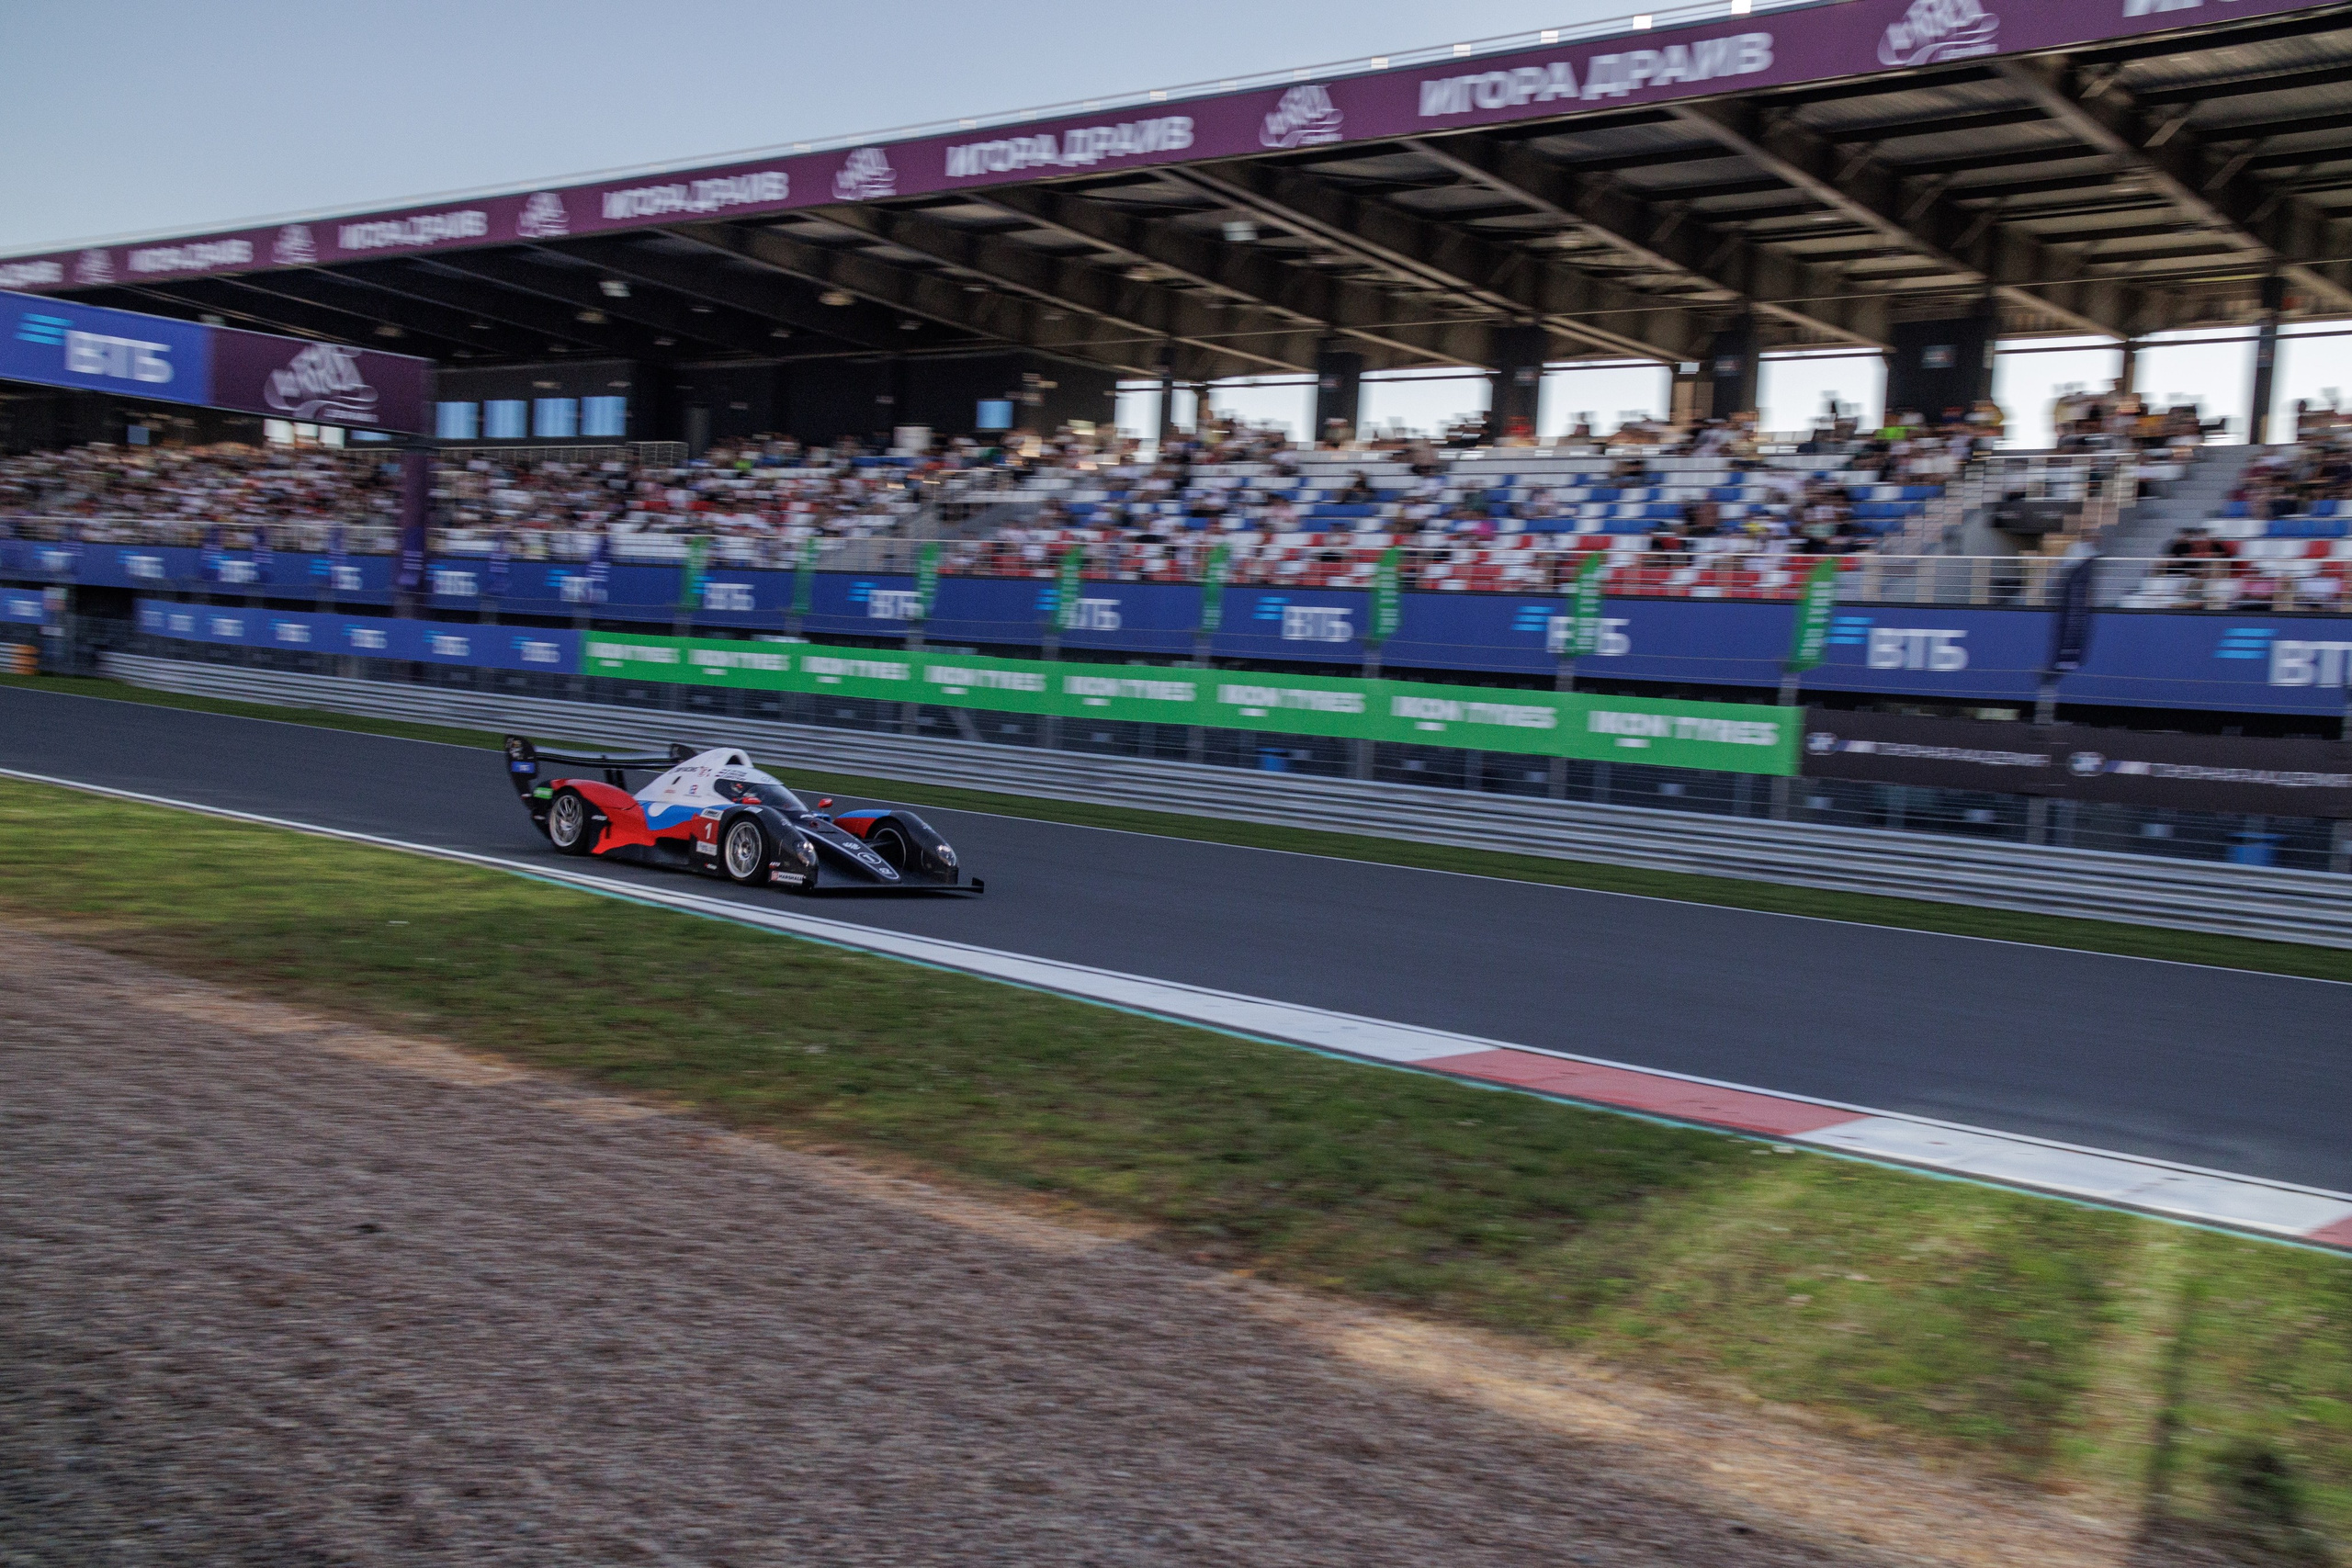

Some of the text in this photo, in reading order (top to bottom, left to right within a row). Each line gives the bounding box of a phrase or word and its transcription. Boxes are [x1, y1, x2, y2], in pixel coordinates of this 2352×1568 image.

[1418, 62, 1580, 117] ИГОРА
[64, 329, 175, 384] ВТБ
[1865, 627, 1969, 671] ВТБ
[2267, 639, 2352, 688] ВТ
[705, 822, 713, 840] 1
